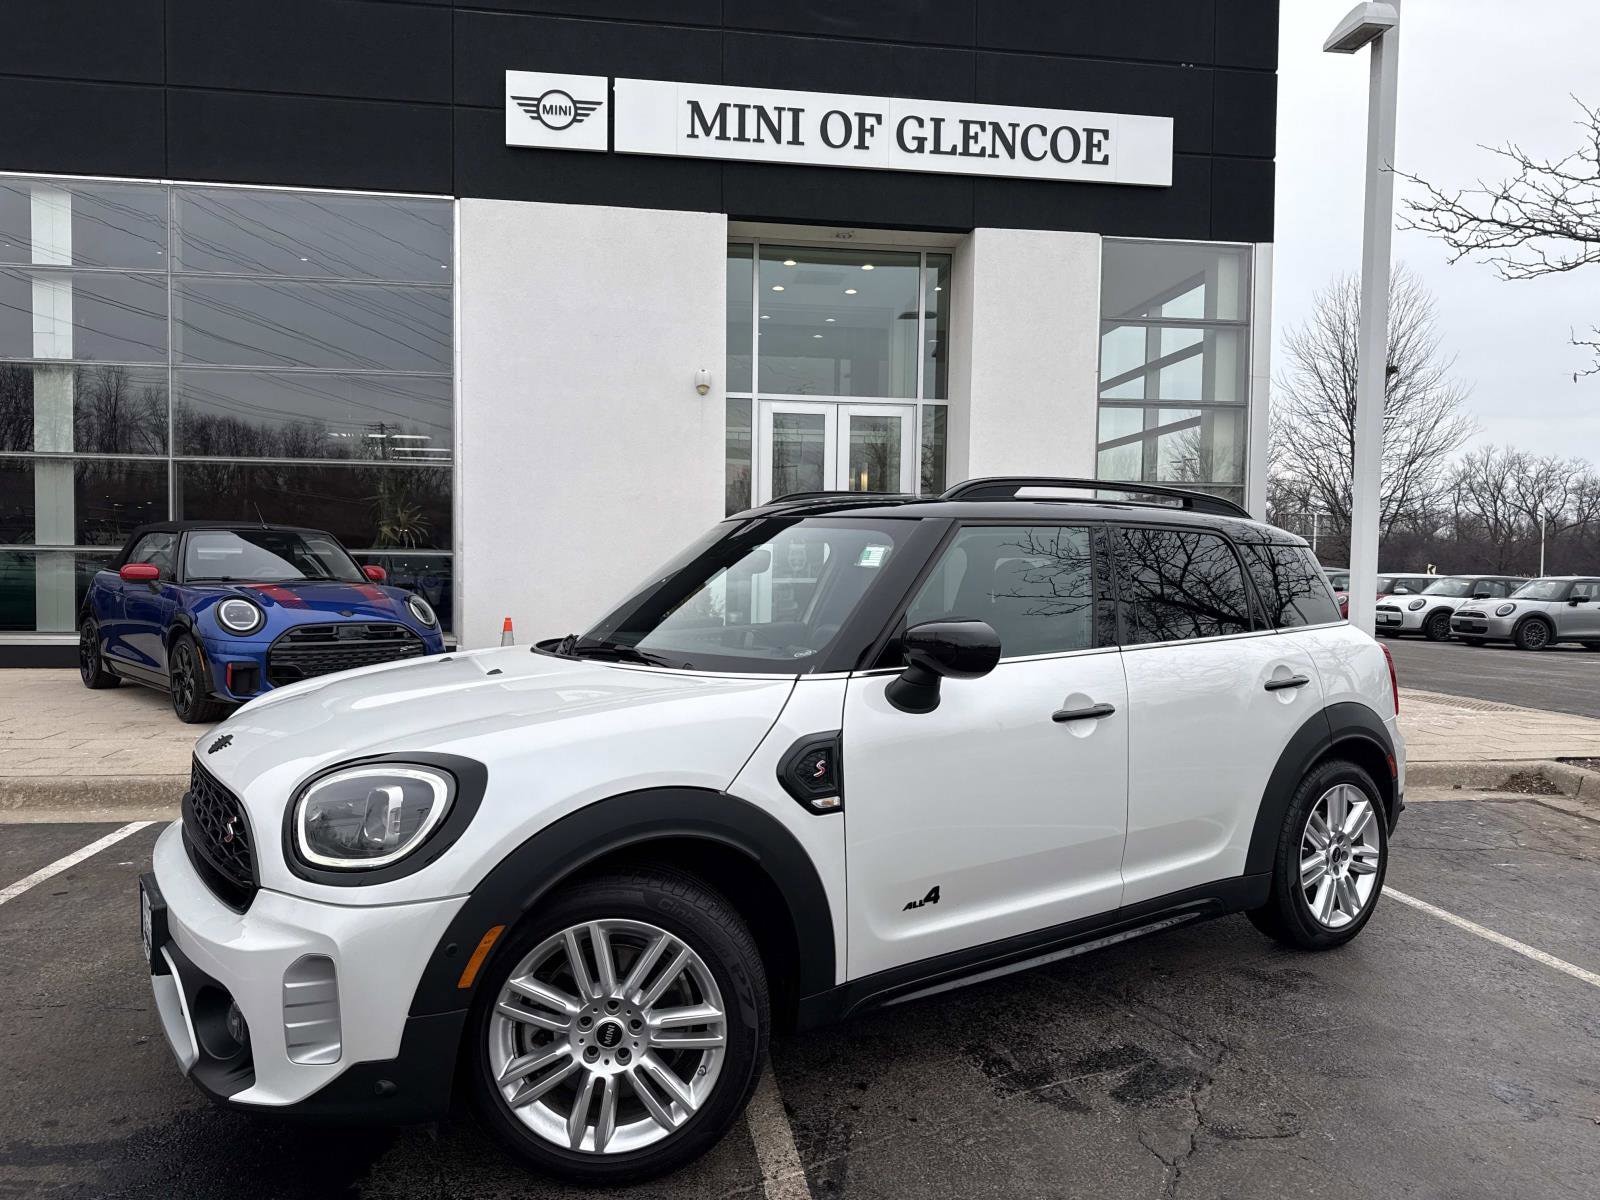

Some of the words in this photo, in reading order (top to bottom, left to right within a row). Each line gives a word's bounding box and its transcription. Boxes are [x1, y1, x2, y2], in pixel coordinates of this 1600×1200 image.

[542, 104, 572, 116] MINI
[686, 100, 805, 146] MINI
[819, 109, 883, 151] OF
[896, 115, 1110, 166] GLENCOE
[813, 760, 825, 777] S
[902, 885, 940, 911] ALL4
[603, 1024, 616, 1045] MINI
